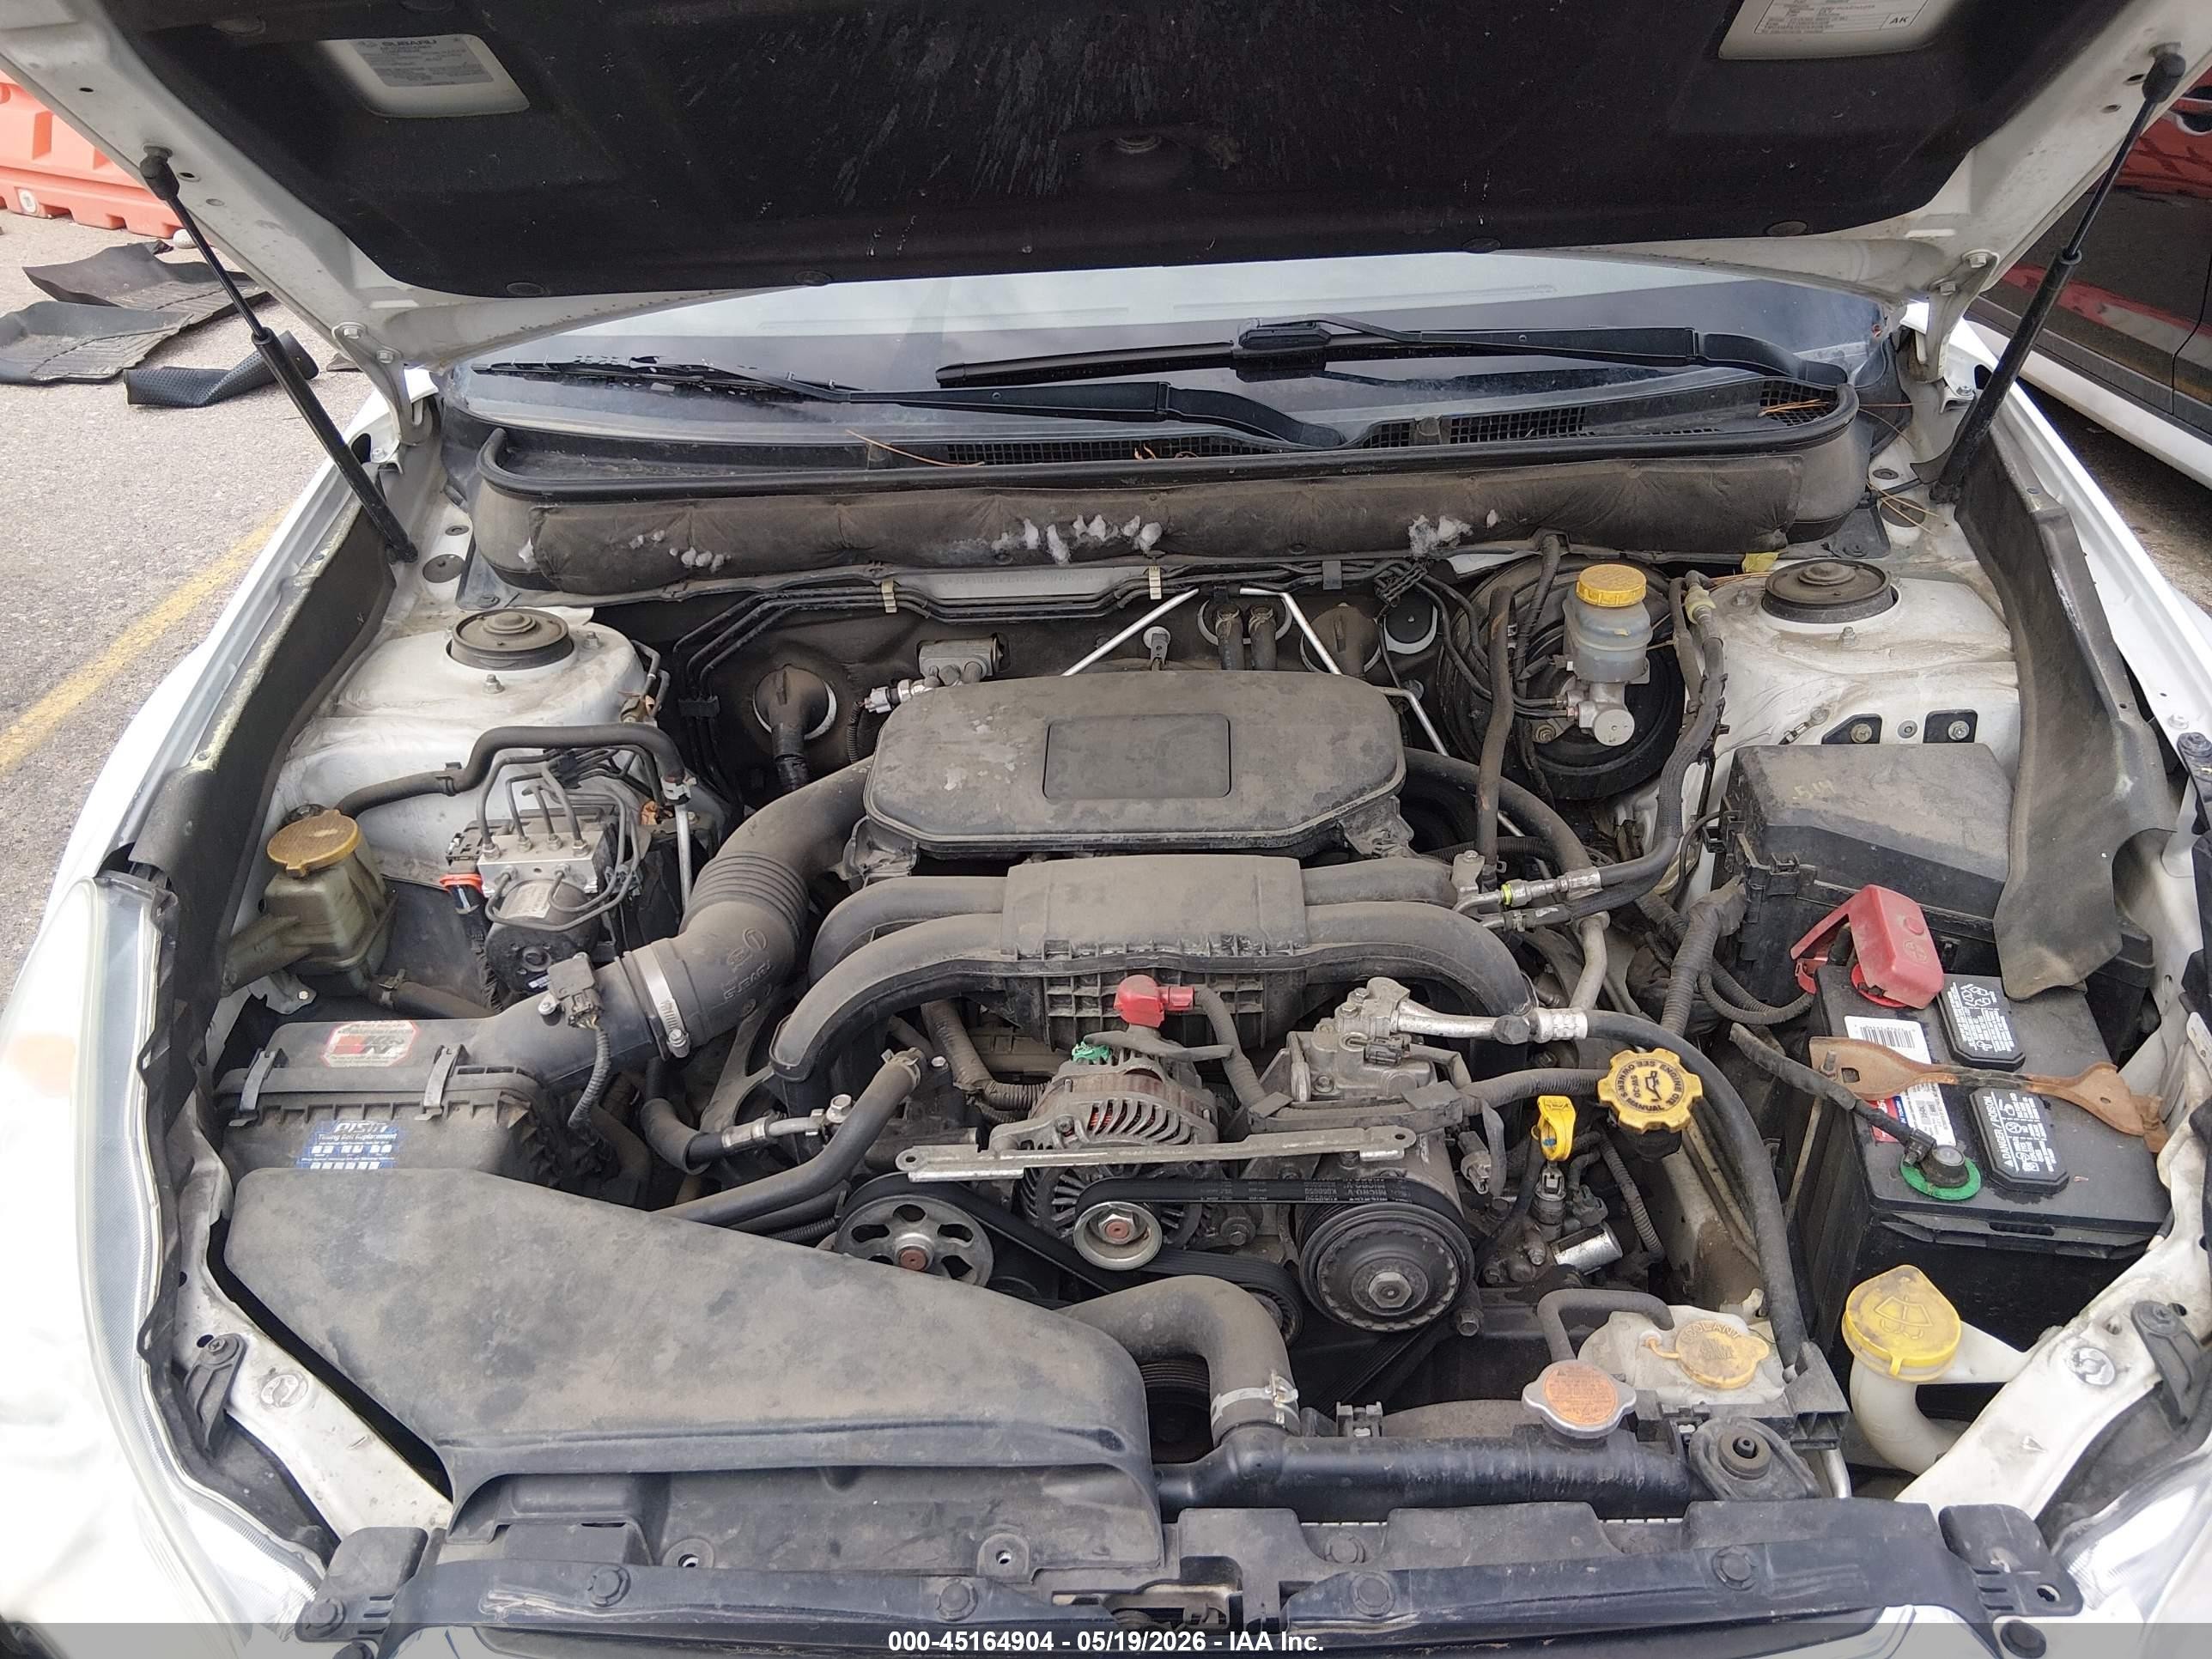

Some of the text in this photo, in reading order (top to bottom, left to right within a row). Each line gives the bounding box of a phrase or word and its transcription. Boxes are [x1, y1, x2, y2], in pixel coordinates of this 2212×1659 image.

[1889, 15, 1910, 25] AK
[1617, 1064, 1635, 1098] OWNER'S
[1626, 1097, 1665, 1112] MANUAL
[1659, 1064, 1682, 1106] ENGINE OIL
[1982, 1096, 2000, 1123] POISON
[355, 1133, 398, 1141] Replacement
[1993, 1128, 2012, 1160] DANGER
[1680, 1319, 1742, 1344] COOLANT
